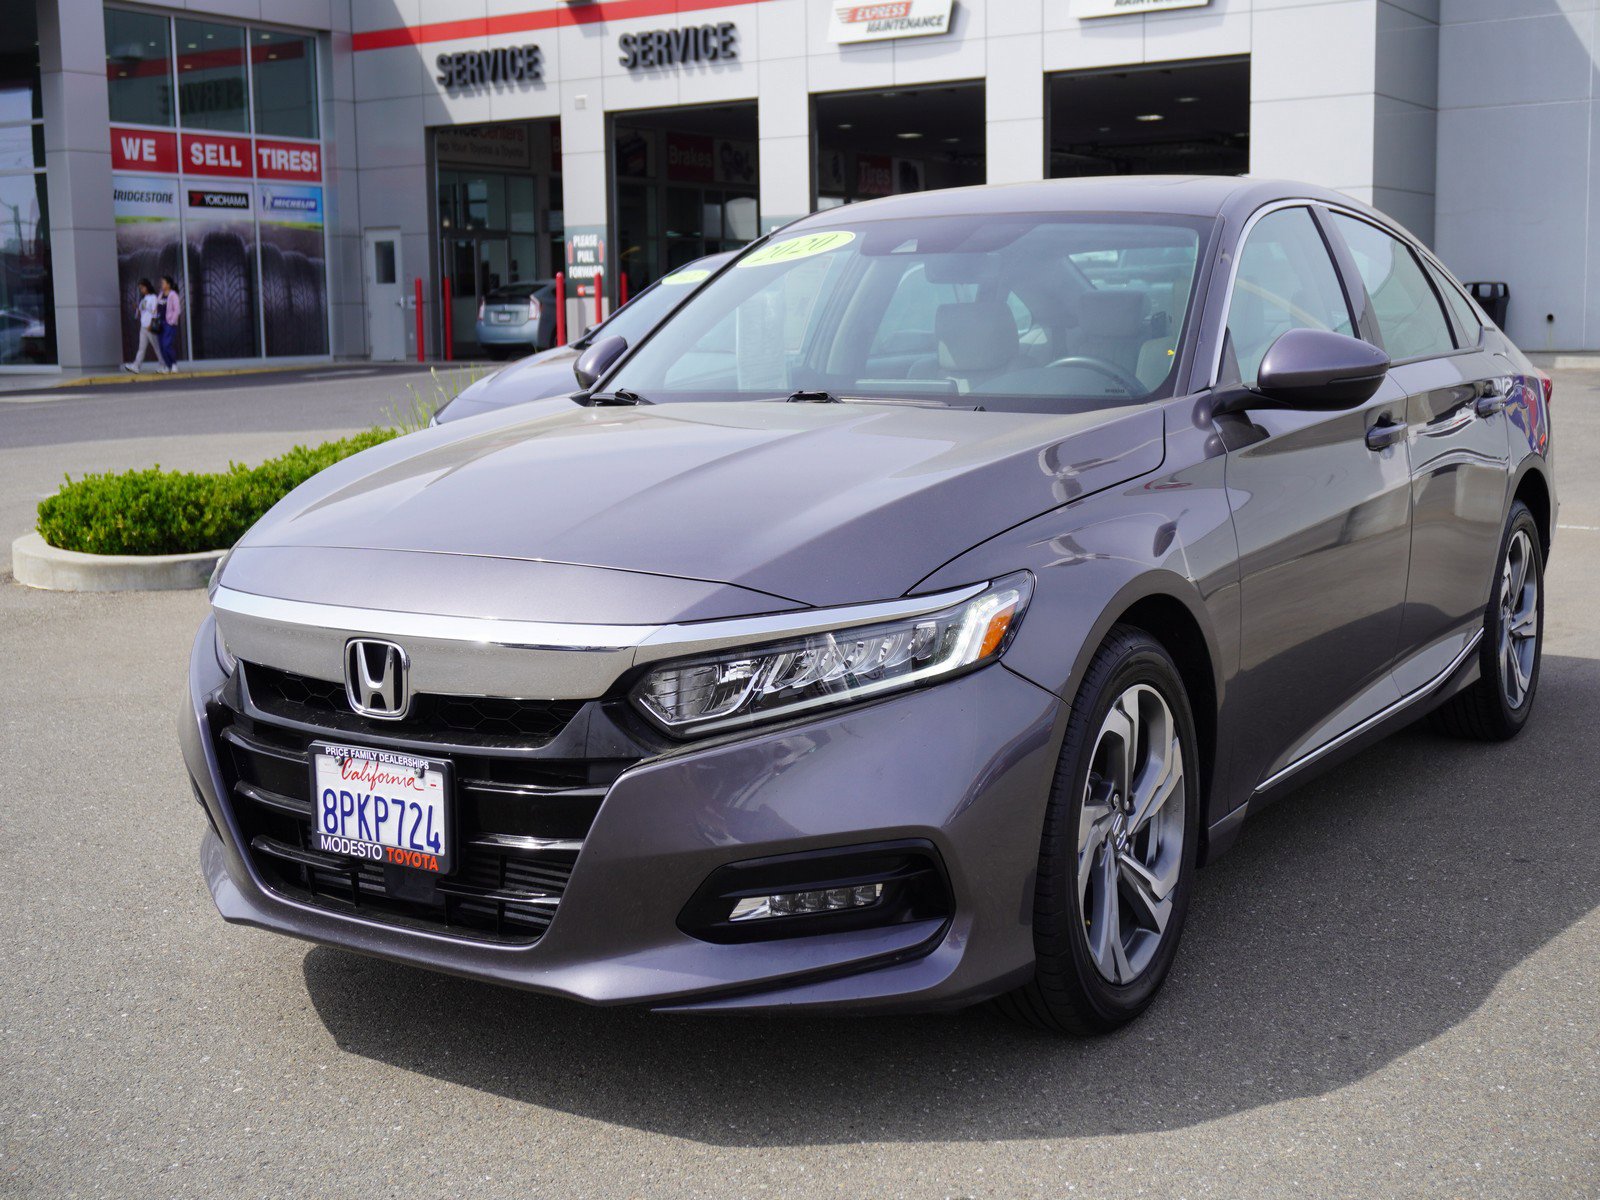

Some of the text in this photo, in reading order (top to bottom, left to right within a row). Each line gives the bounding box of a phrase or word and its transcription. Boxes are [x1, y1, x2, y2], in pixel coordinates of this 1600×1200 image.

[855, 3, 906, 20] EXPRESS
[866, 15, 945, 33] MAINTENANCE
[619, 22, 736, 69] SERVICE
[436, 44, 540, 88] SERVICE
[121, 137, 318, 172] WE SELL TIRES!
[669, 144, 712, 168] Brakes
[859, 161, 890, 185] Tires
[204, 194, 247, 206] YOKOHAMA
[274, 198, 316, 209] MICHELIN
[573, 234, 598, 248] PLEASE
[577, 250, 594, 263] PULL
[325, 747, 430, 770] PRICE FAMILY DEALERSHIPS
[341, 757, 424, 791] California
[323, 788, 440, 854] 8PKP724
[321, 835, 439, 871] MODESTO TOYOTA
